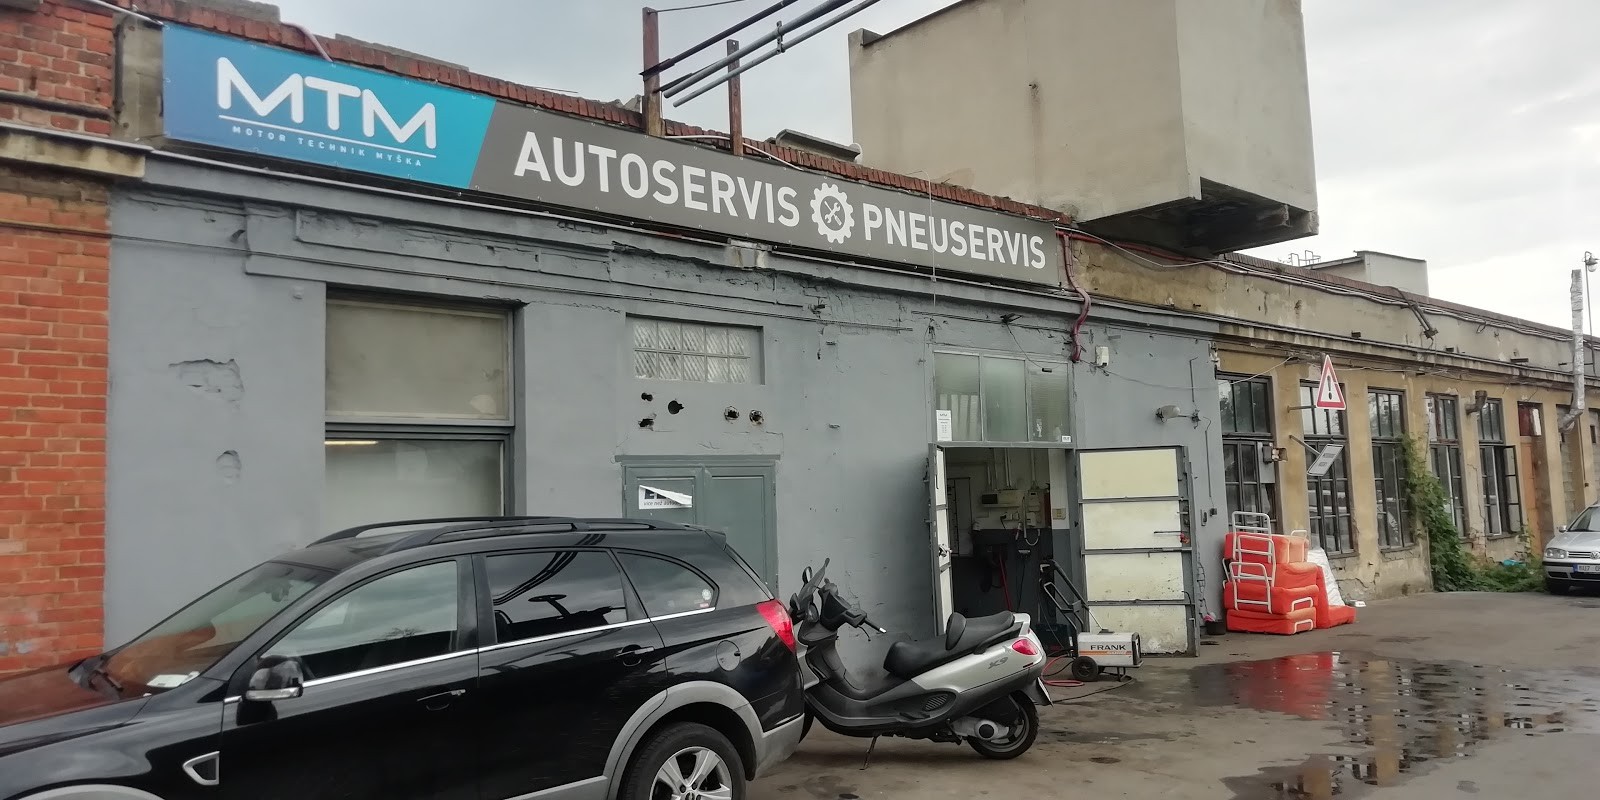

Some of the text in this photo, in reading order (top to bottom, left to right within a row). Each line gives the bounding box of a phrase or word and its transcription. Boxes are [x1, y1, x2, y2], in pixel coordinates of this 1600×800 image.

[217, 57, 437, 150] MTM
[232, 125, 422, 167] MOTOR TECHNIK MYŠKA
[513, 131, 1047, 269] AUTOSERVIS PNEUSERVIS
